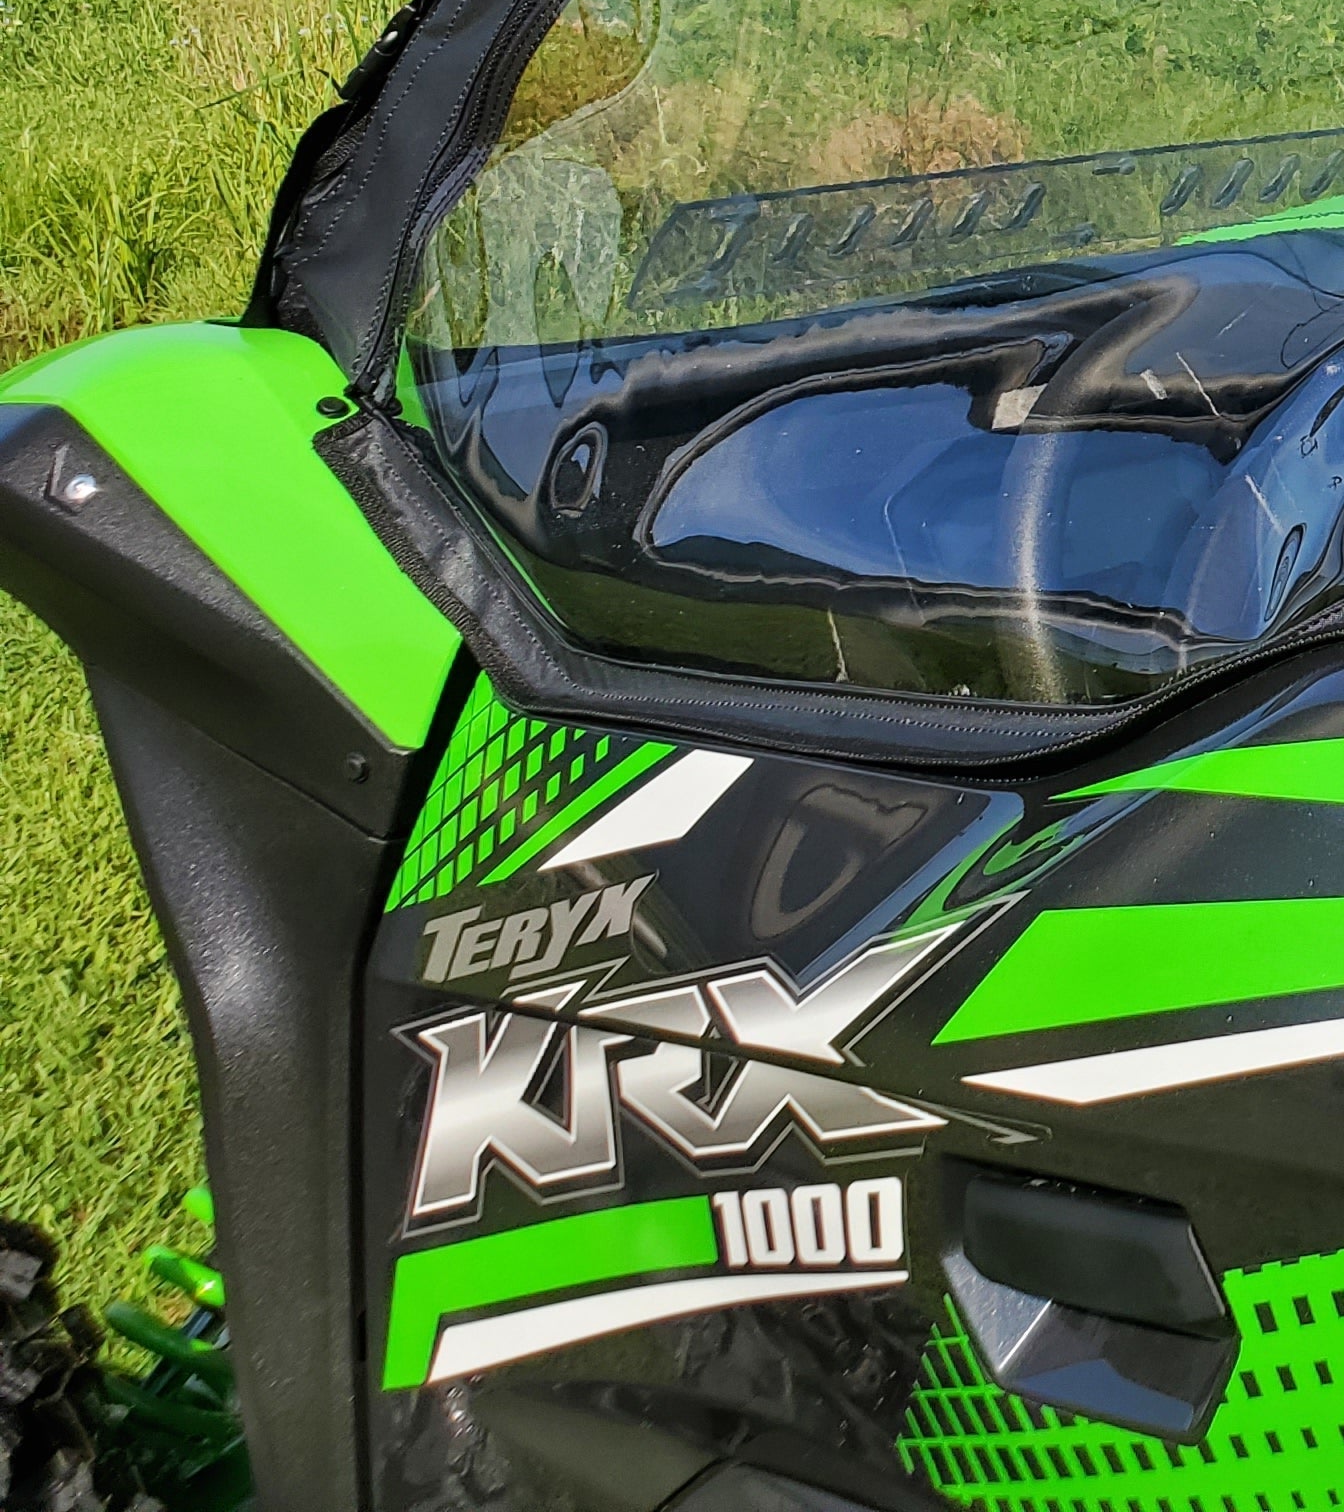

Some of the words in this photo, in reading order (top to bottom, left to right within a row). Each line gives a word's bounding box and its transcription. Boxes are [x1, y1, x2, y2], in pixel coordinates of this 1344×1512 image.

[424, 872, 657, 983] TERYX
[407, 916, 972, 1223] KRX
[712, 1177, 906, 1268] 1000
